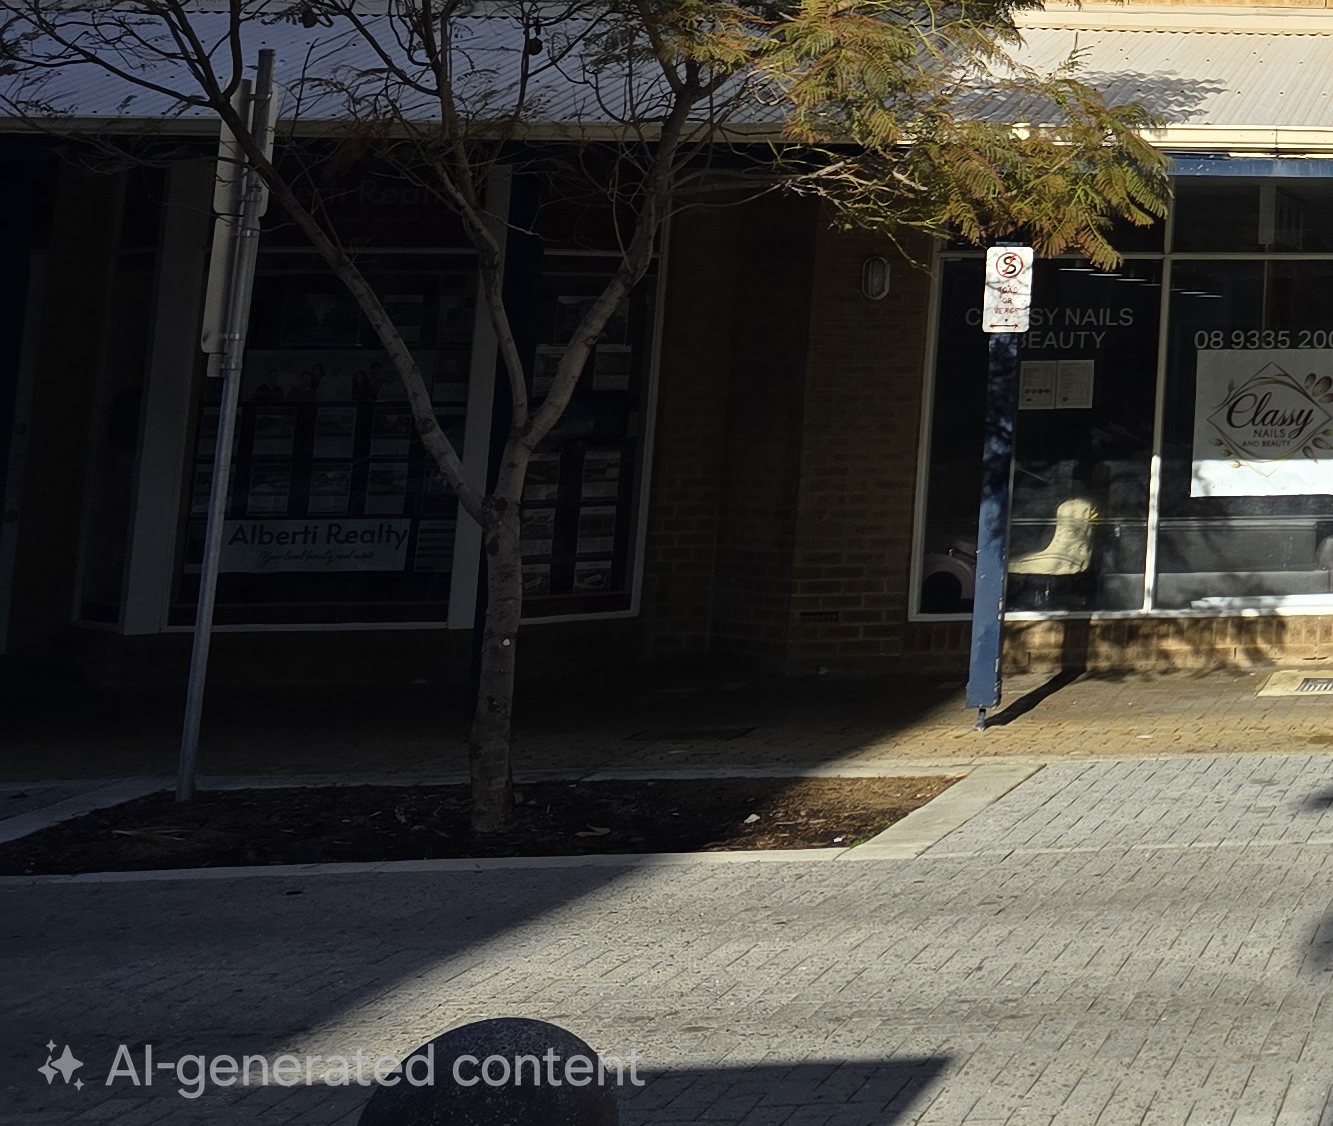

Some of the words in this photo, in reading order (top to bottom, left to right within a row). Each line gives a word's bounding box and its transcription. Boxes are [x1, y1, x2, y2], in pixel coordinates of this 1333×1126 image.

[1065, 307, 1134, 326] NAILS
[1194, 330, 1224, 349] 08
[1231, 329, 1290, 349] 9335
[1226, 392, 1314, 440] Classy
[1253, 429, 1286, 439] NAILS
[1242, 440, 1260, 448] AND
[1261, 440, 1291, 448] BEAUTY
[228, 524, 319, 546] Alberti
[326, 523, 409, 551] Realty
